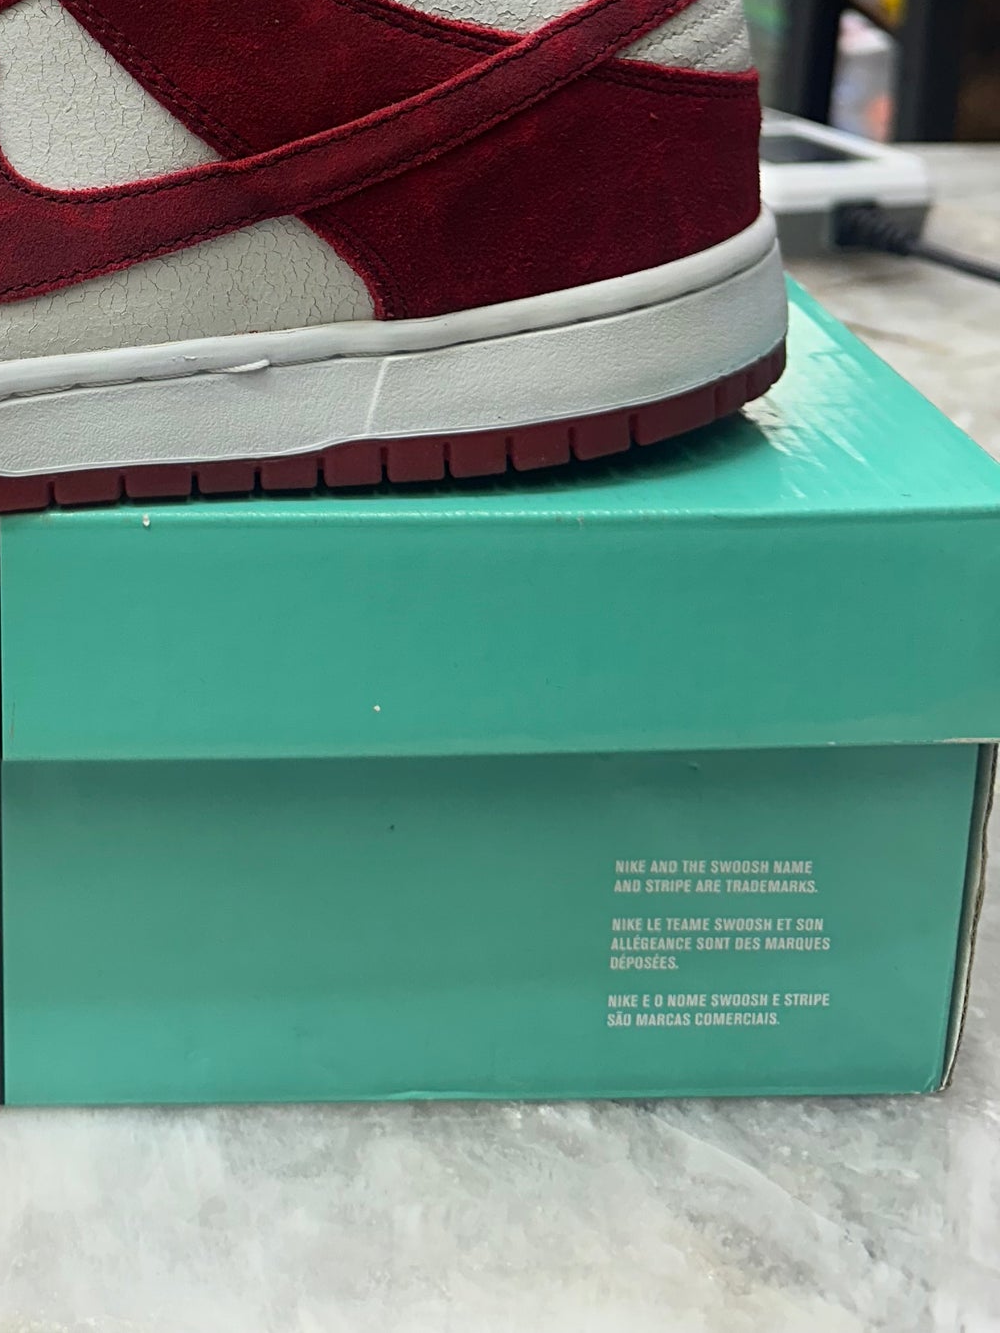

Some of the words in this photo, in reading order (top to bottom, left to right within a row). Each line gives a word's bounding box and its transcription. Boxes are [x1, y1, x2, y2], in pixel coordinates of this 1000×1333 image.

[615, 860, 646, 873] NIKE
[650, 860, 677, 873] AND
[682, 860, 705, 873] THE
[711, 861, 769, 873] SWOOSH
[774, 861, 812, 874] NAME
[614, 880, 640, 892] AND
[645, 880, 691, 892] STRIPE
[696, 880, 721, 893] ARE
[726, 880, 818, 893] TRADEMARKS.
[612, 918, 642, 931] NIKE
[647, 918, 661, 931] LE
[714, 918, 772, 931] SWOOSH
[777, 918, 792, 931] ET
[796, 918, 823, 931] SON
[611, 935, 691, 950] ALLÉGEANCE
[696, 937, 730, 950] SONT
[735, 937, 760, 950] DES
[765, 937, 830, 950] MARQUES
[610, 954, 678, 969] DÉPOSÉES.
[608, 994, 638, 1007] NIKE
[643, 994, 650, 1007] E
[654, 994, 662, 1007] O
[668, 994, 707, 1007] NOME
[711, 994, 768, 1007] SWOOSH
[773, 994, 780, 1006] E
[784, 994, 830, 1006] STRIPE
[607, 1011, 631, 1026] SÃO
[636, 1013, 690, 1026] MARCAS
[695, 1013, 779, 1025] COMERCIAIS.
